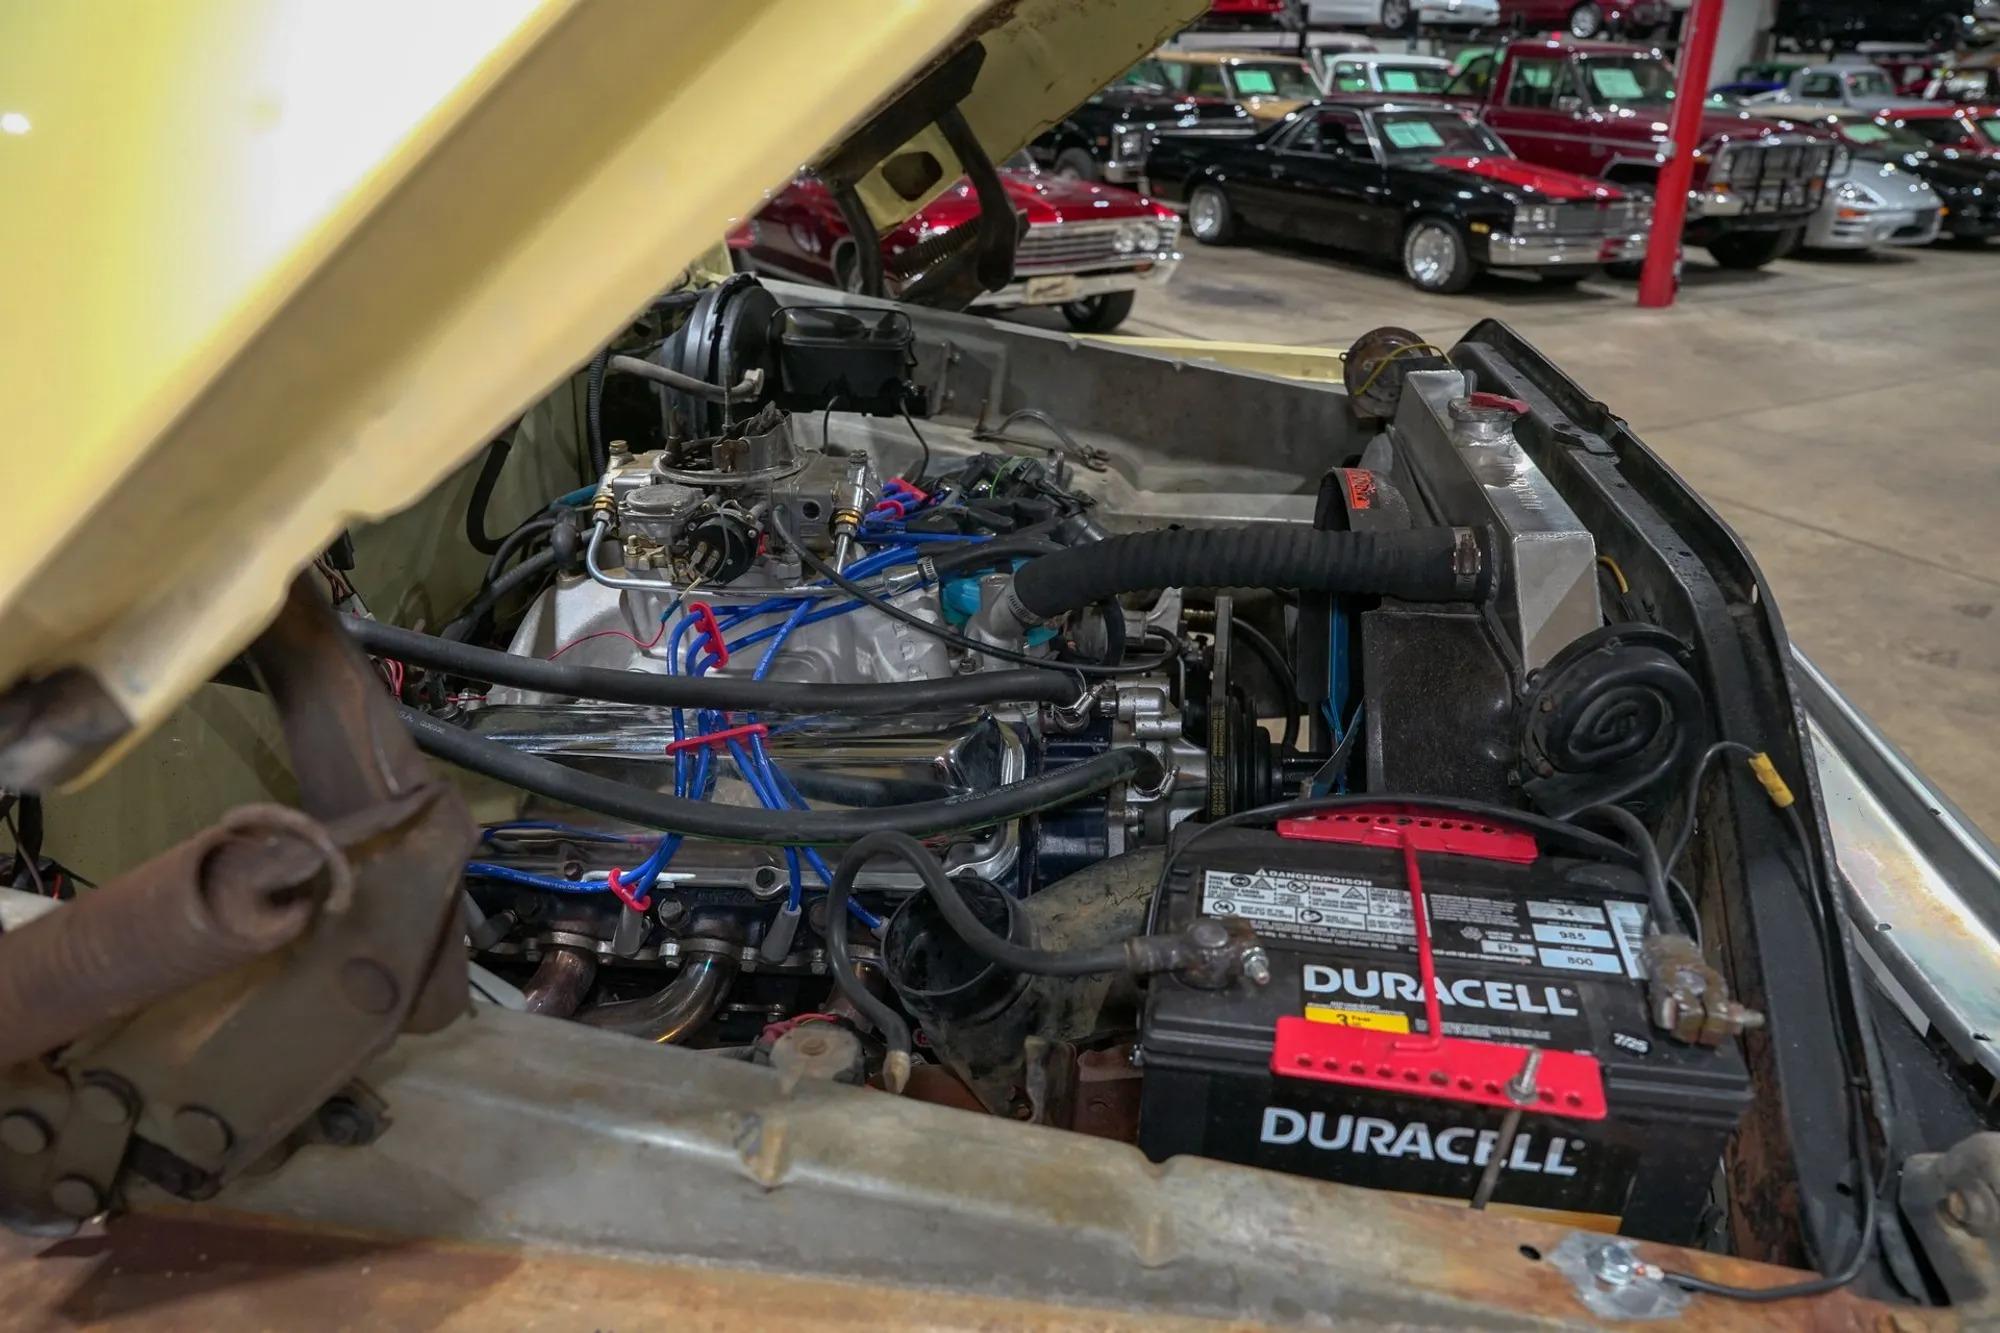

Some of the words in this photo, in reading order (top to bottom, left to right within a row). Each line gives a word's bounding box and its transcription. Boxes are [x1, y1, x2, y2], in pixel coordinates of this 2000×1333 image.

[1557, 908, 1574, 917] 34
[1559, 931, 1587, 941] 985
[1497, 942, 1519, 953] Pb
[1567, 956, 1594, 967] 800
[1303, 964, 1579, 1017] DURACELL
[1613, 1032, 1649, 1053] 7/25
[1259, 1106, 1578, 1177] DURACELL
